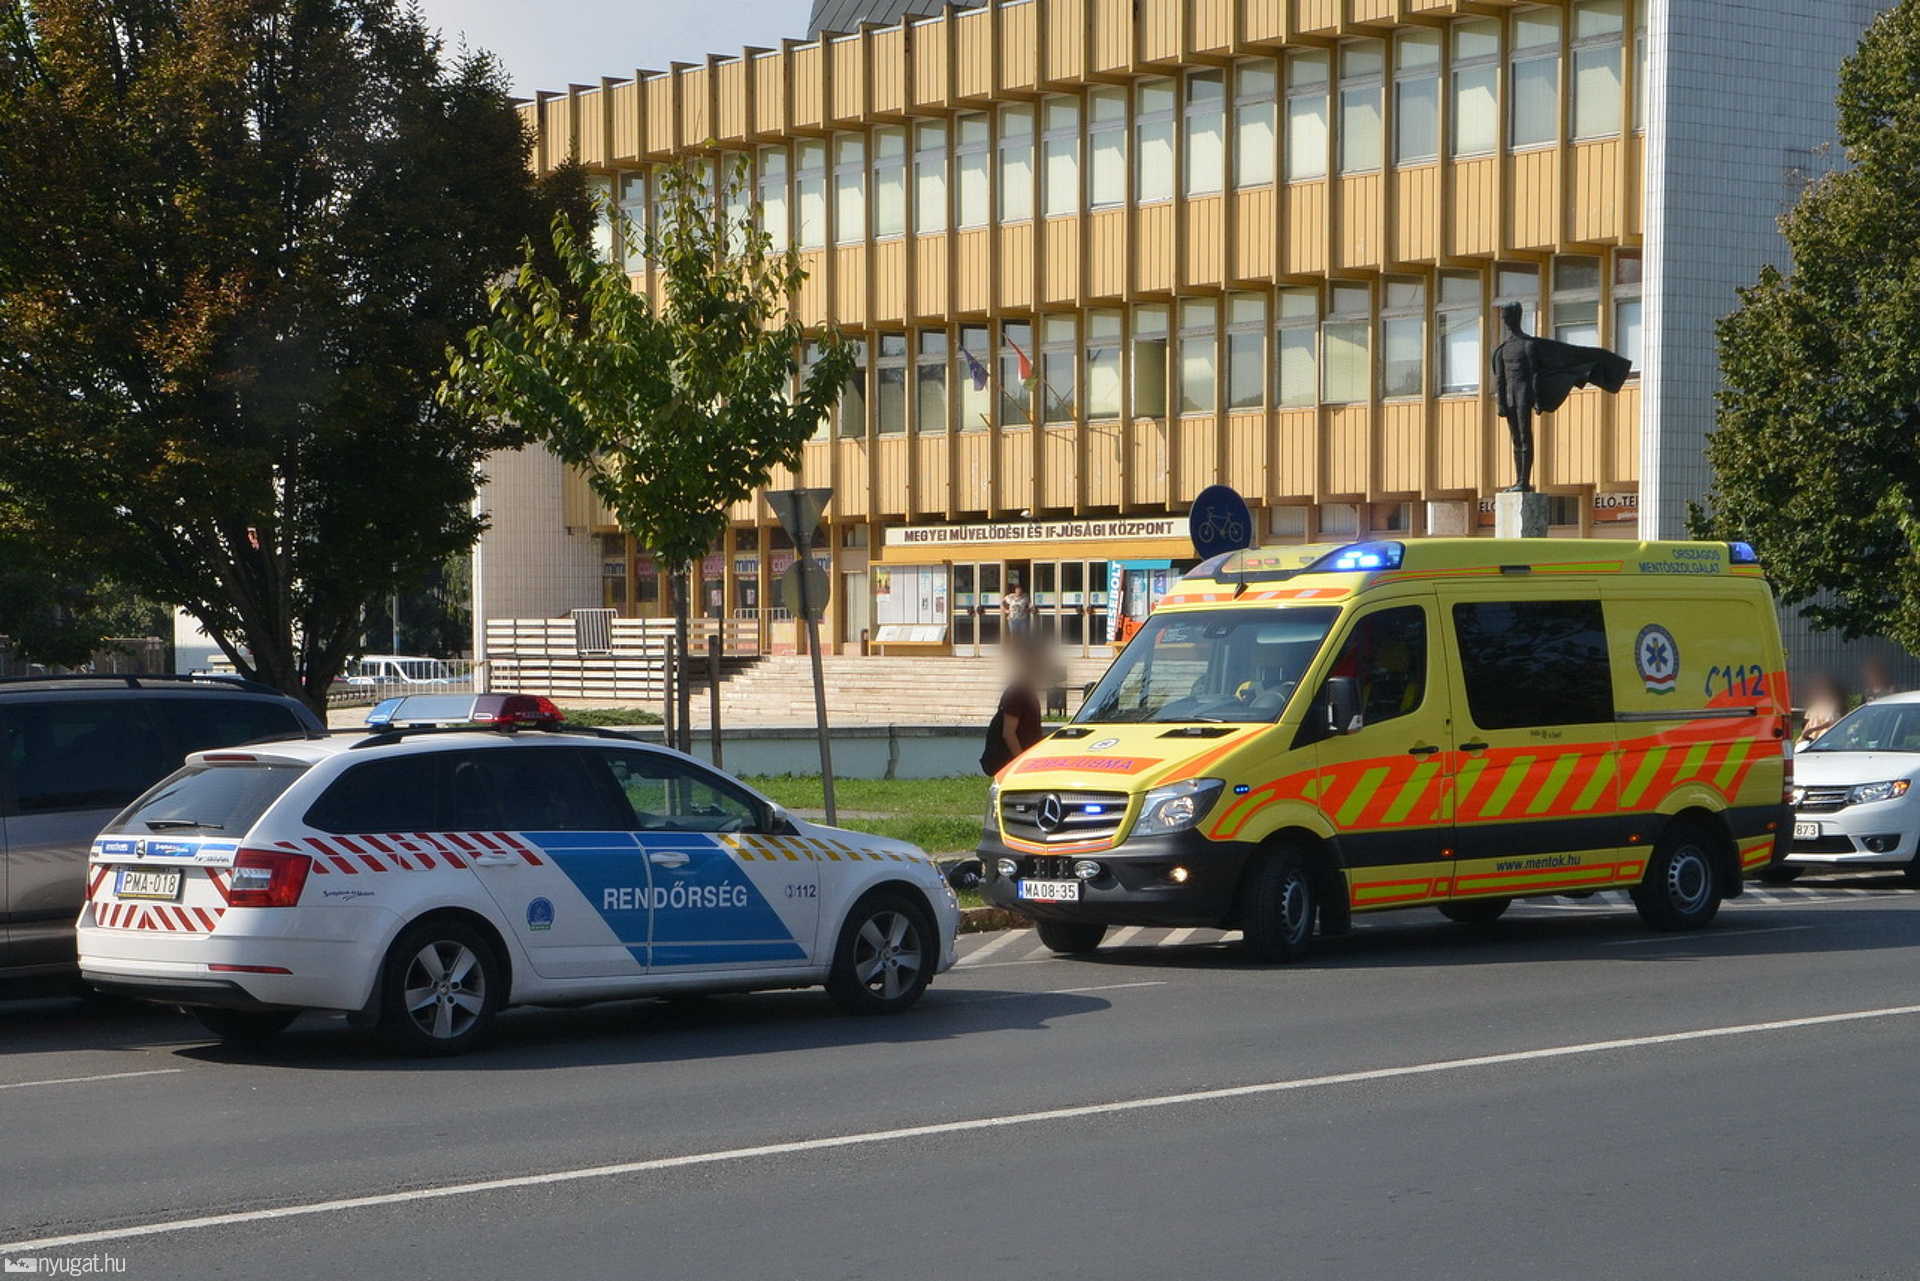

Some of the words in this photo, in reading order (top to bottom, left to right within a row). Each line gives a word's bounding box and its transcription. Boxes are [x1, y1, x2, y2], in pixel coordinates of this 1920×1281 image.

[905, 530, 947, 542] MEGYEI
[1027, 524, 1042, 539] ÉS
[1046, 521, 1105, 538] IFJÚSÁGI
[1109, 520, 1174, 537] KÖZPONT
[1106, 560, 1121, 641] MESEBOLT
[1722, 664, 1765, 696] 112
[124, 873, 177, 893] PMA-018
[603, 880, 748, 910] RENDŐRSÉG
[796, 884, 817, 898] 112
